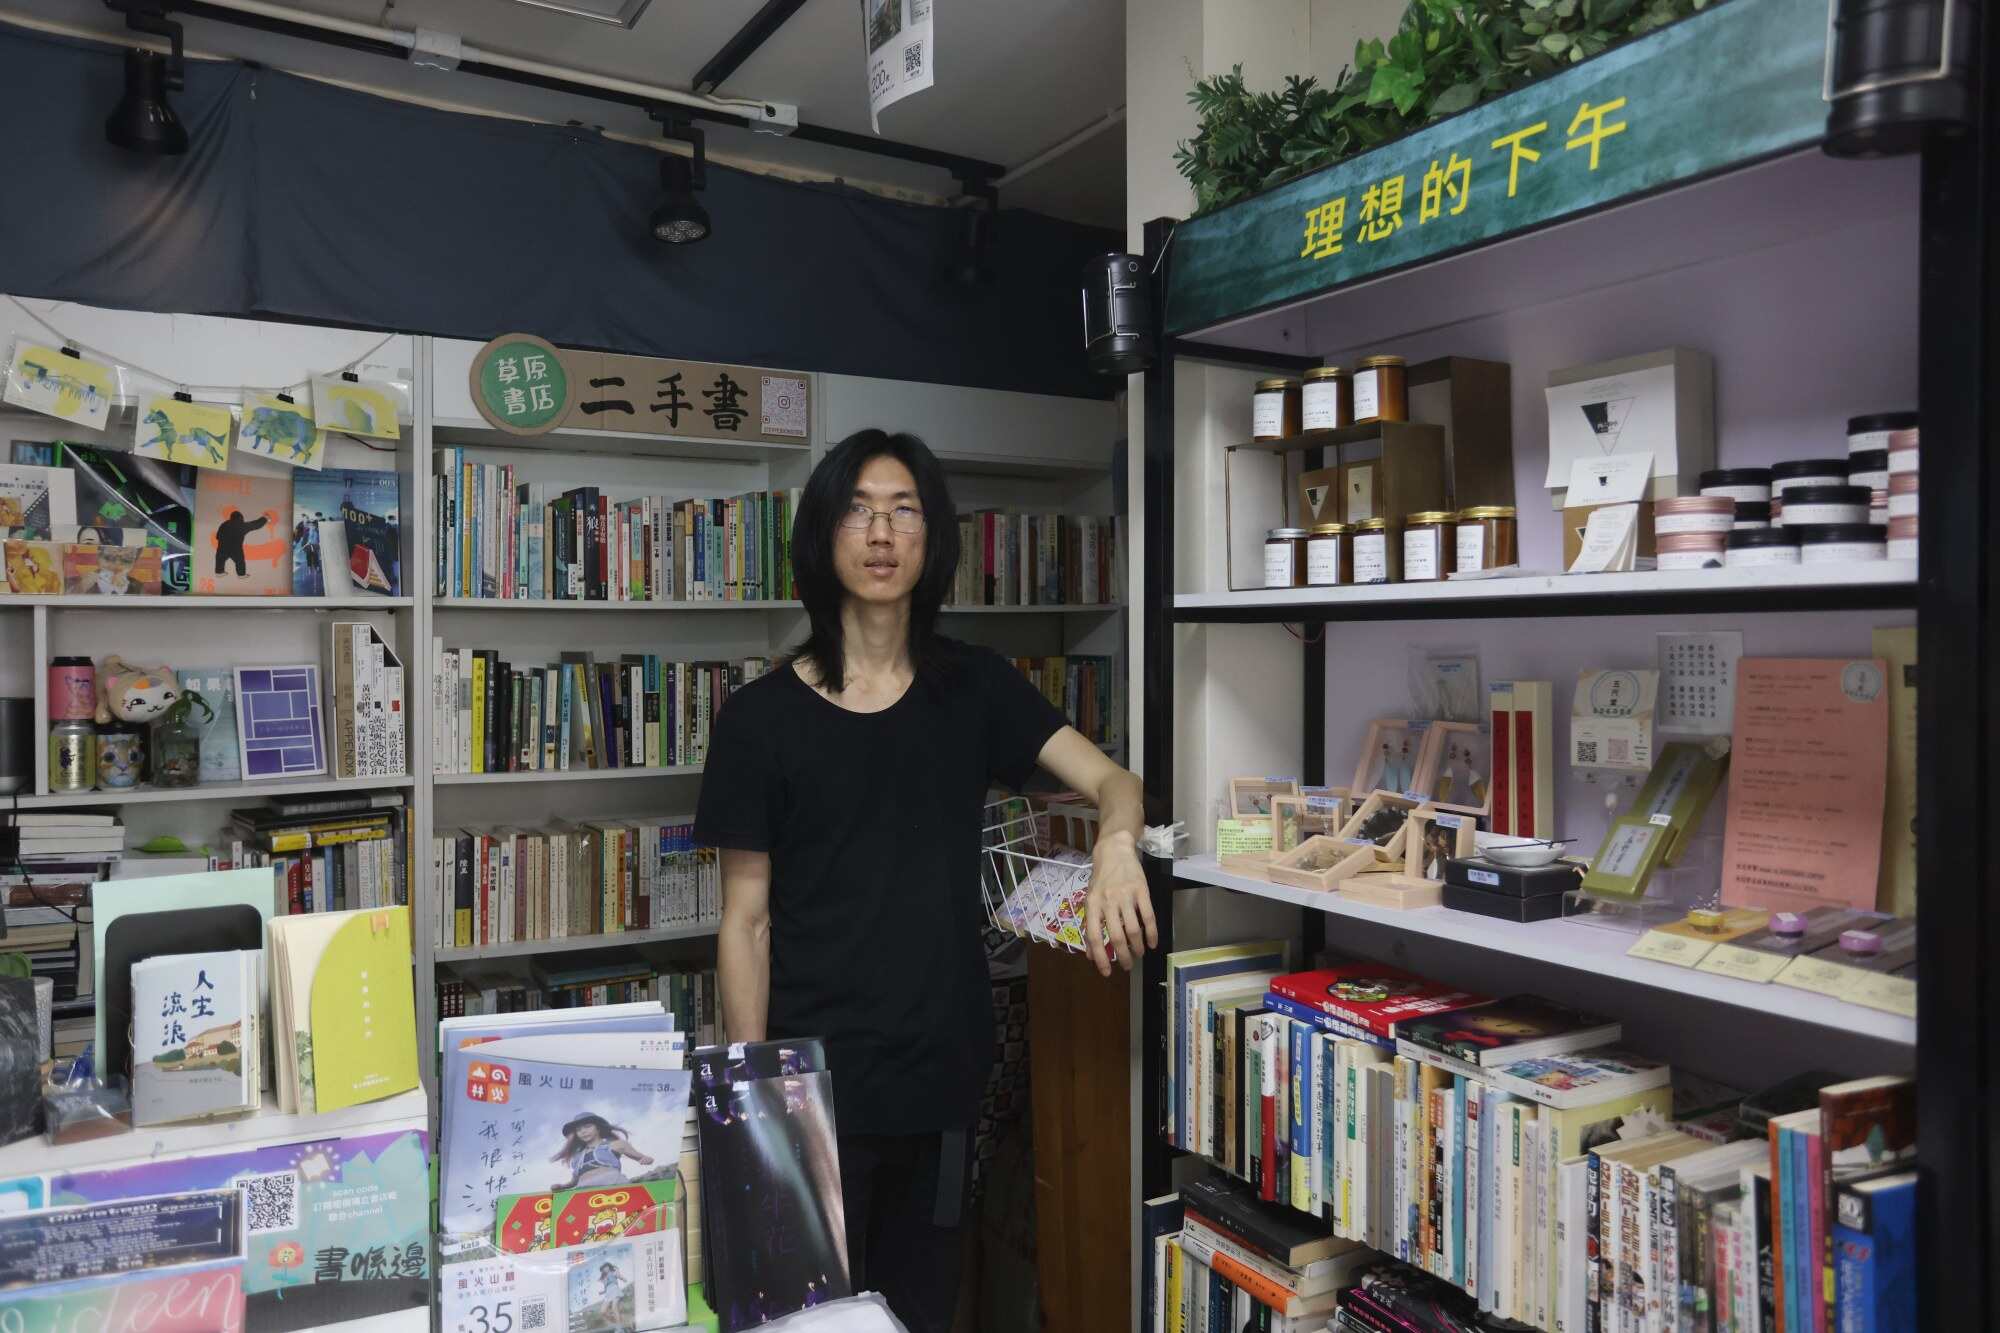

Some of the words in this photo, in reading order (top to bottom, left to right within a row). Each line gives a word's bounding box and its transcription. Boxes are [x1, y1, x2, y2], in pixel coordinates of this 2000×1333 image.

[1301, 97, 1627, 261] 理想的下午
[498, 355, 548, 384] 草原
[502, 384, 554, 415] 書店
[580, 373, 749, 431] 二手書
[344, 720, 355, 776] APPENDIX
[161, 991, 188, 1047] 流浪
[190, 969, 216, 1018] 人生
[469, 1300, 513, 1333] 35
